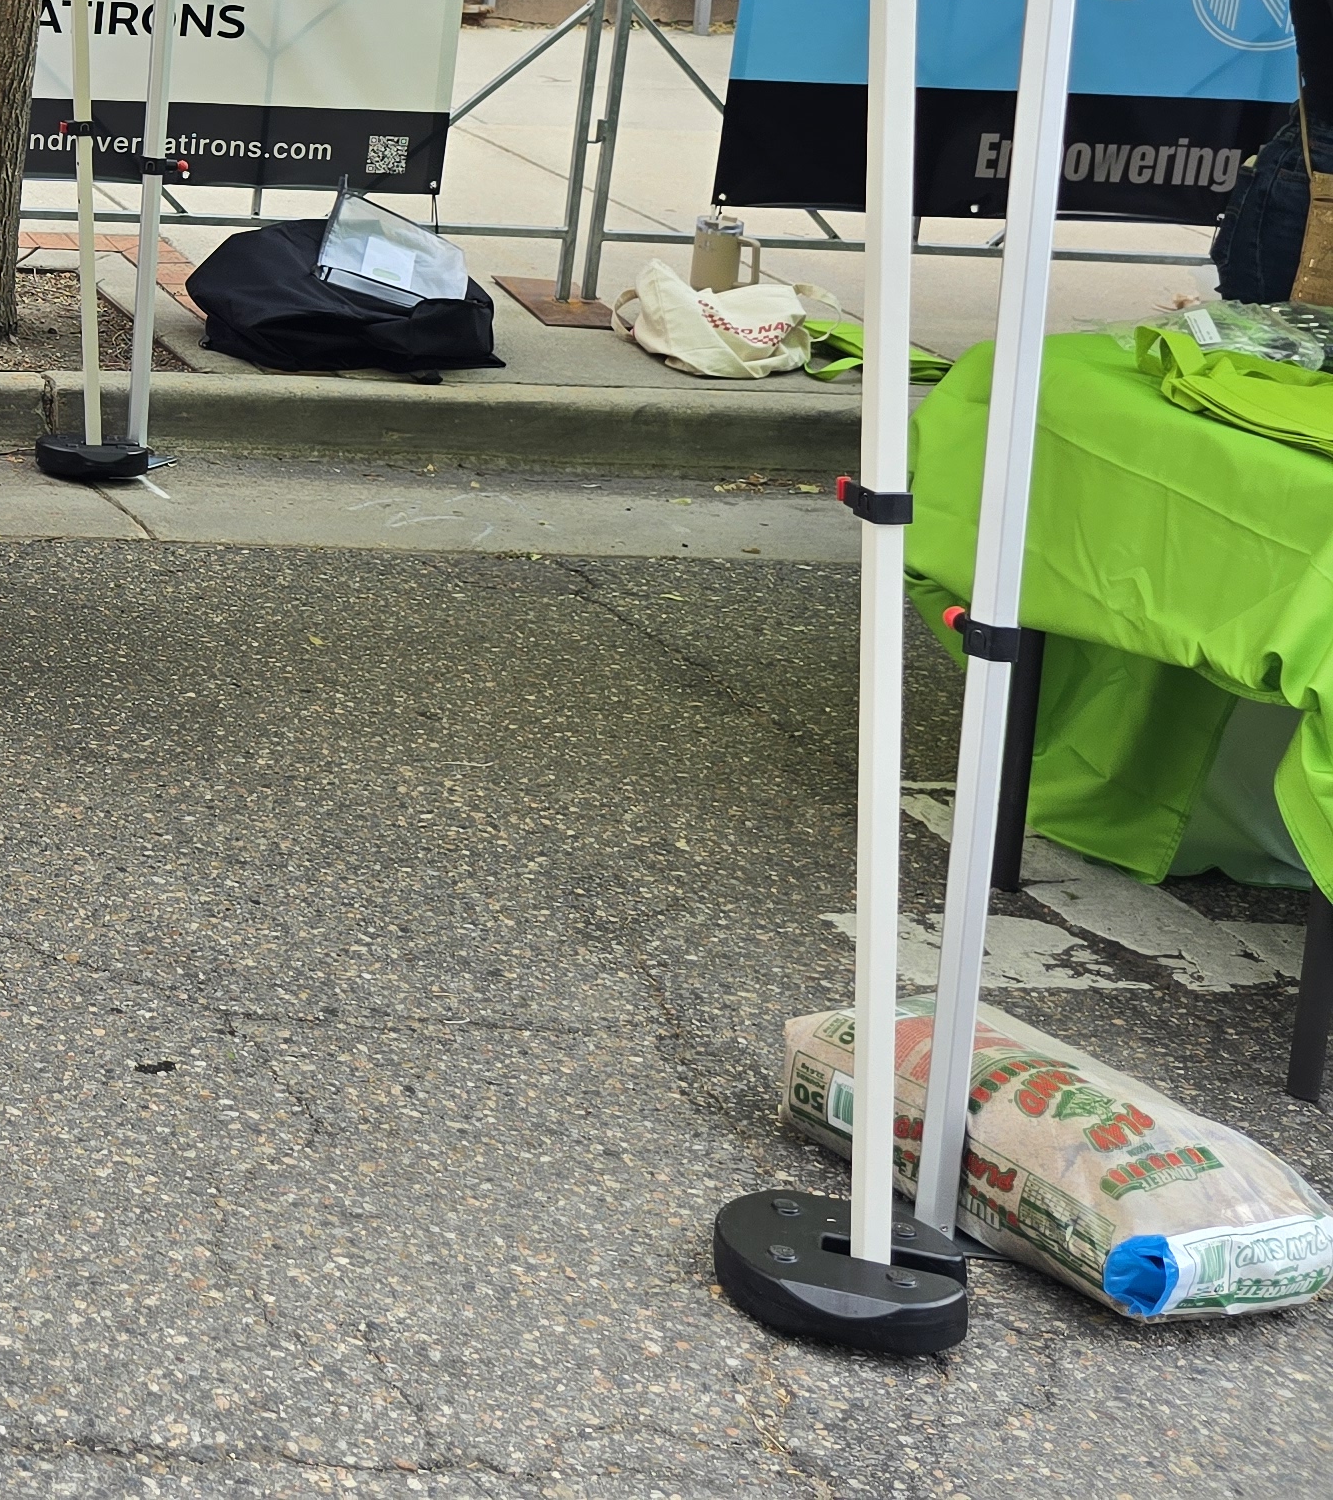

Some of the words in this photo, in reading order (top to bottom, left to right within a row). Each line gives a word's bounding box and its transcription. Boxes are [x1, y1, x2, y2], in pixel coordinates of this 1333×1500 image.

[794, 1082, 825, 1113] 50
[1083, 1102, 1155, 1153] PLAY
[964, 1148, 1018, 1192] PLA
[1139, 1164, 1198, 1192] QUIKRETE
